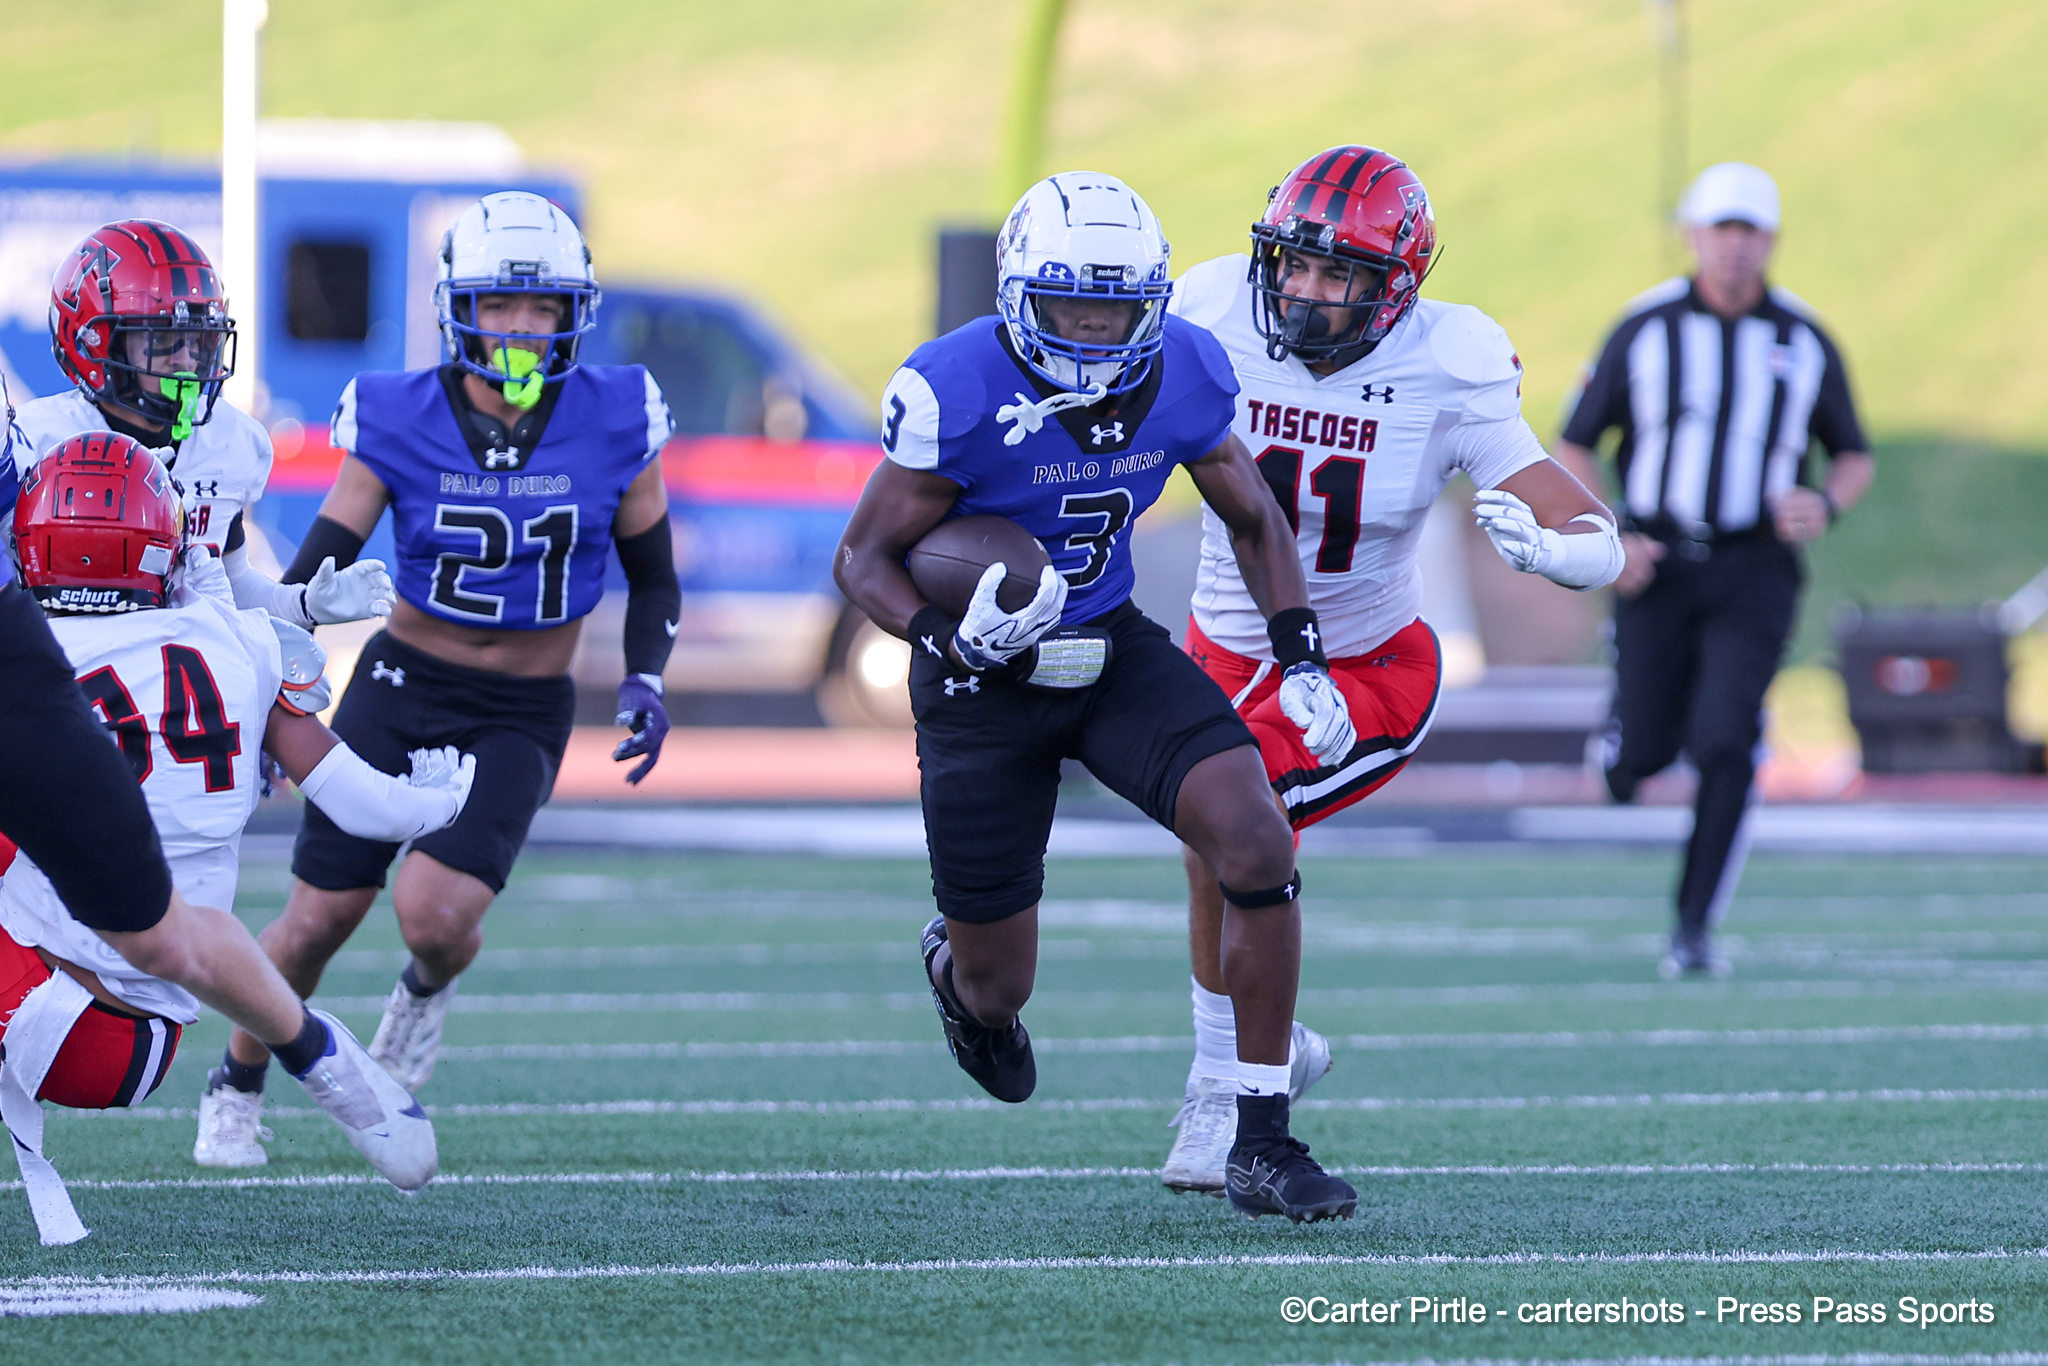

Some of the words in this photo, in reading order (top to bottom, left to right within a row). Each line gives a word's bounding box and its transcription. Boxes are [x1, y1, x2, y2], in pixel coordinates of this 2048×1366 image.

[1096, 267, 1122, 277] schutt
[882, 392, 907, 453] 3
[1248, 399, 1379, 453] TASCOSA
[439, 472, 500, 496] PALO
[507, 474, 572, 497] DURO
[1032, 461, 1101, 484] PALO
[1110, 449, 1165, 478] DURO
[1057, 486, 1134, 590] 3
[427, 503, 580, 625] 21
[59, 587, 121, 604] schutt
